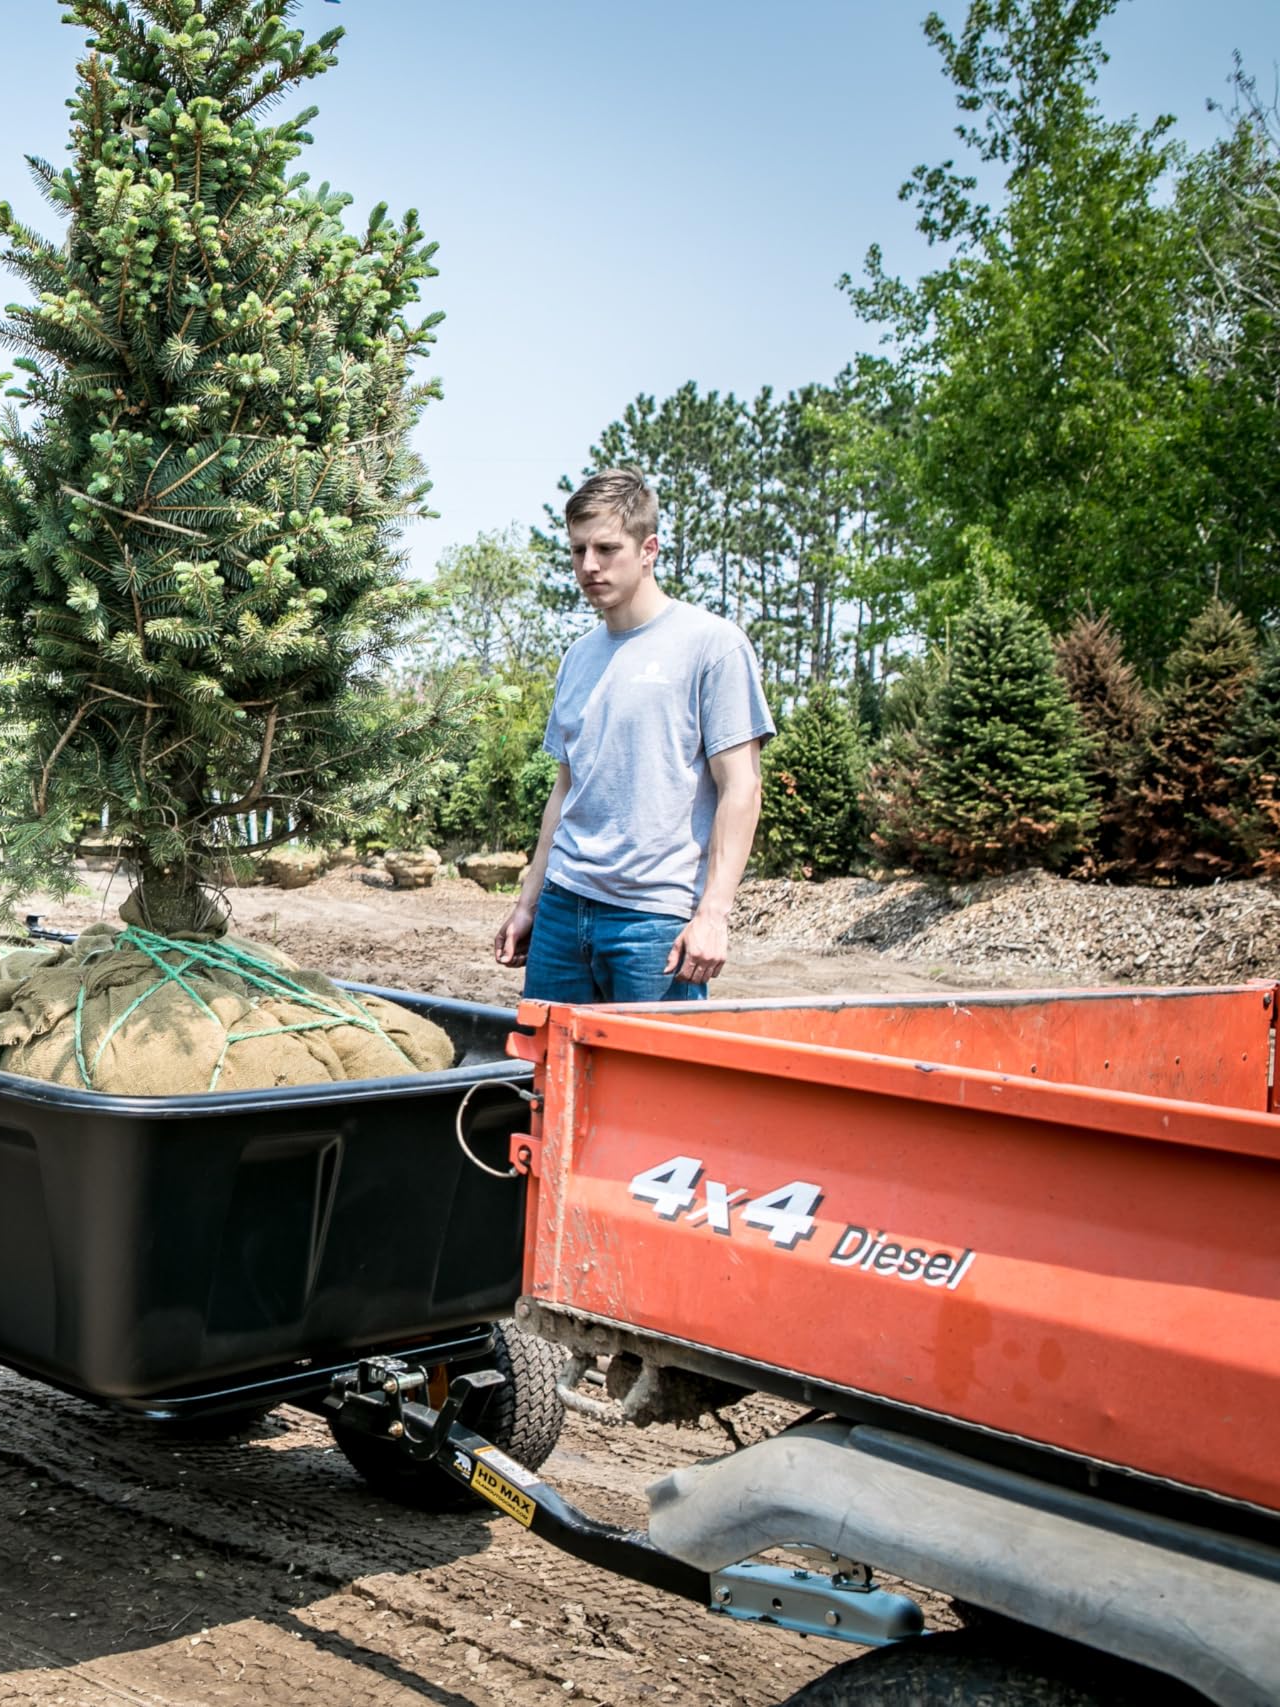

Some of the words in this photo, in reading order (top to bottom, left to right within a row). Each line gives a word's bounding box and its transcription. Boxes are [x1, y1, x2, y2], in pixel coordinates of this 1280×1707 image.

[829, 1223, 976, 1290] Diesel
[478, 1468, 497, 1488] HD
[500, 1485, 531, 1514] MAX
